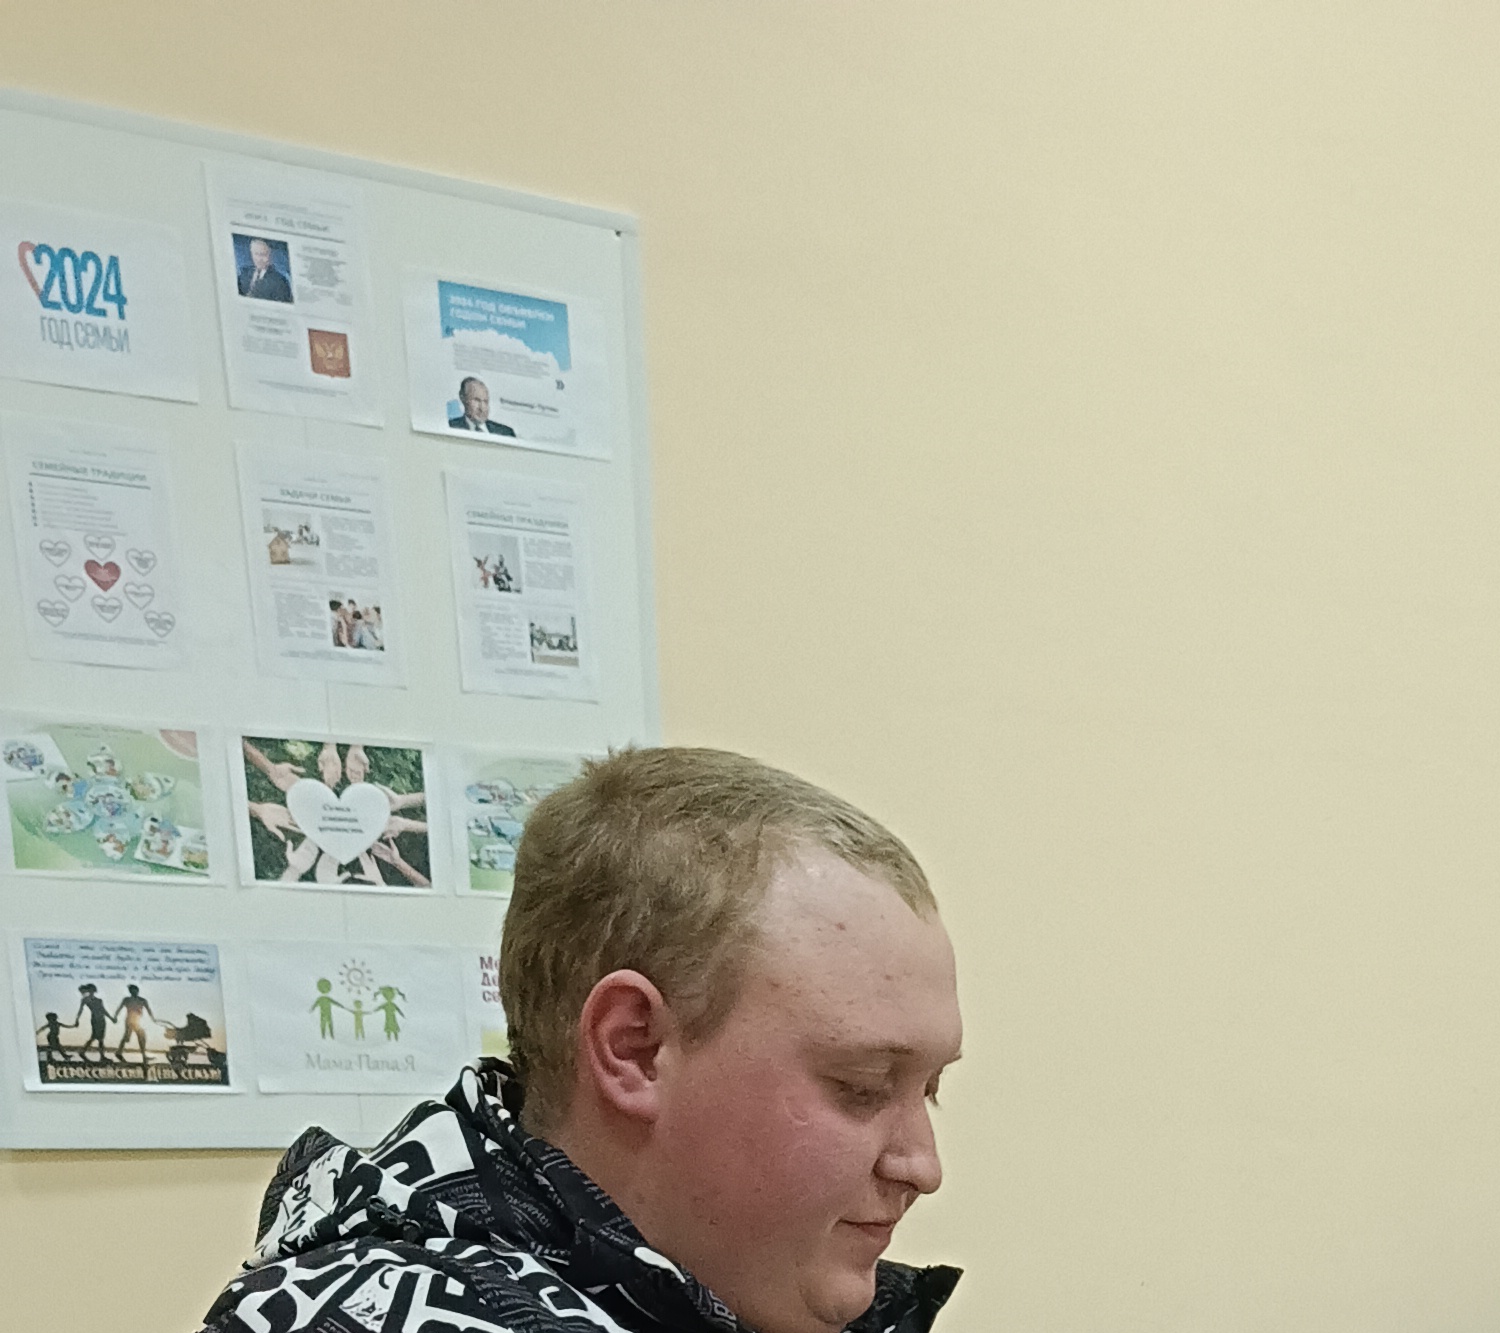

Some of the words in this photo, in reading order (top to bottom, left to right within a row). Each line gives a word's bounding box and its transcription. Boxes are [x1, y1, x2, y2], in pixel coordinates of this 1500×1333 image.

[33, 243, 127, 320] 2024
[40, 316, 74, 351] ГОД
[74, 320, 130, 352] СЕМЬИ
[305, 1053, 354, 1072] Мама
[357, 1054, 401, 1072] Папа
[405, 1054, 416, 1072] Я
